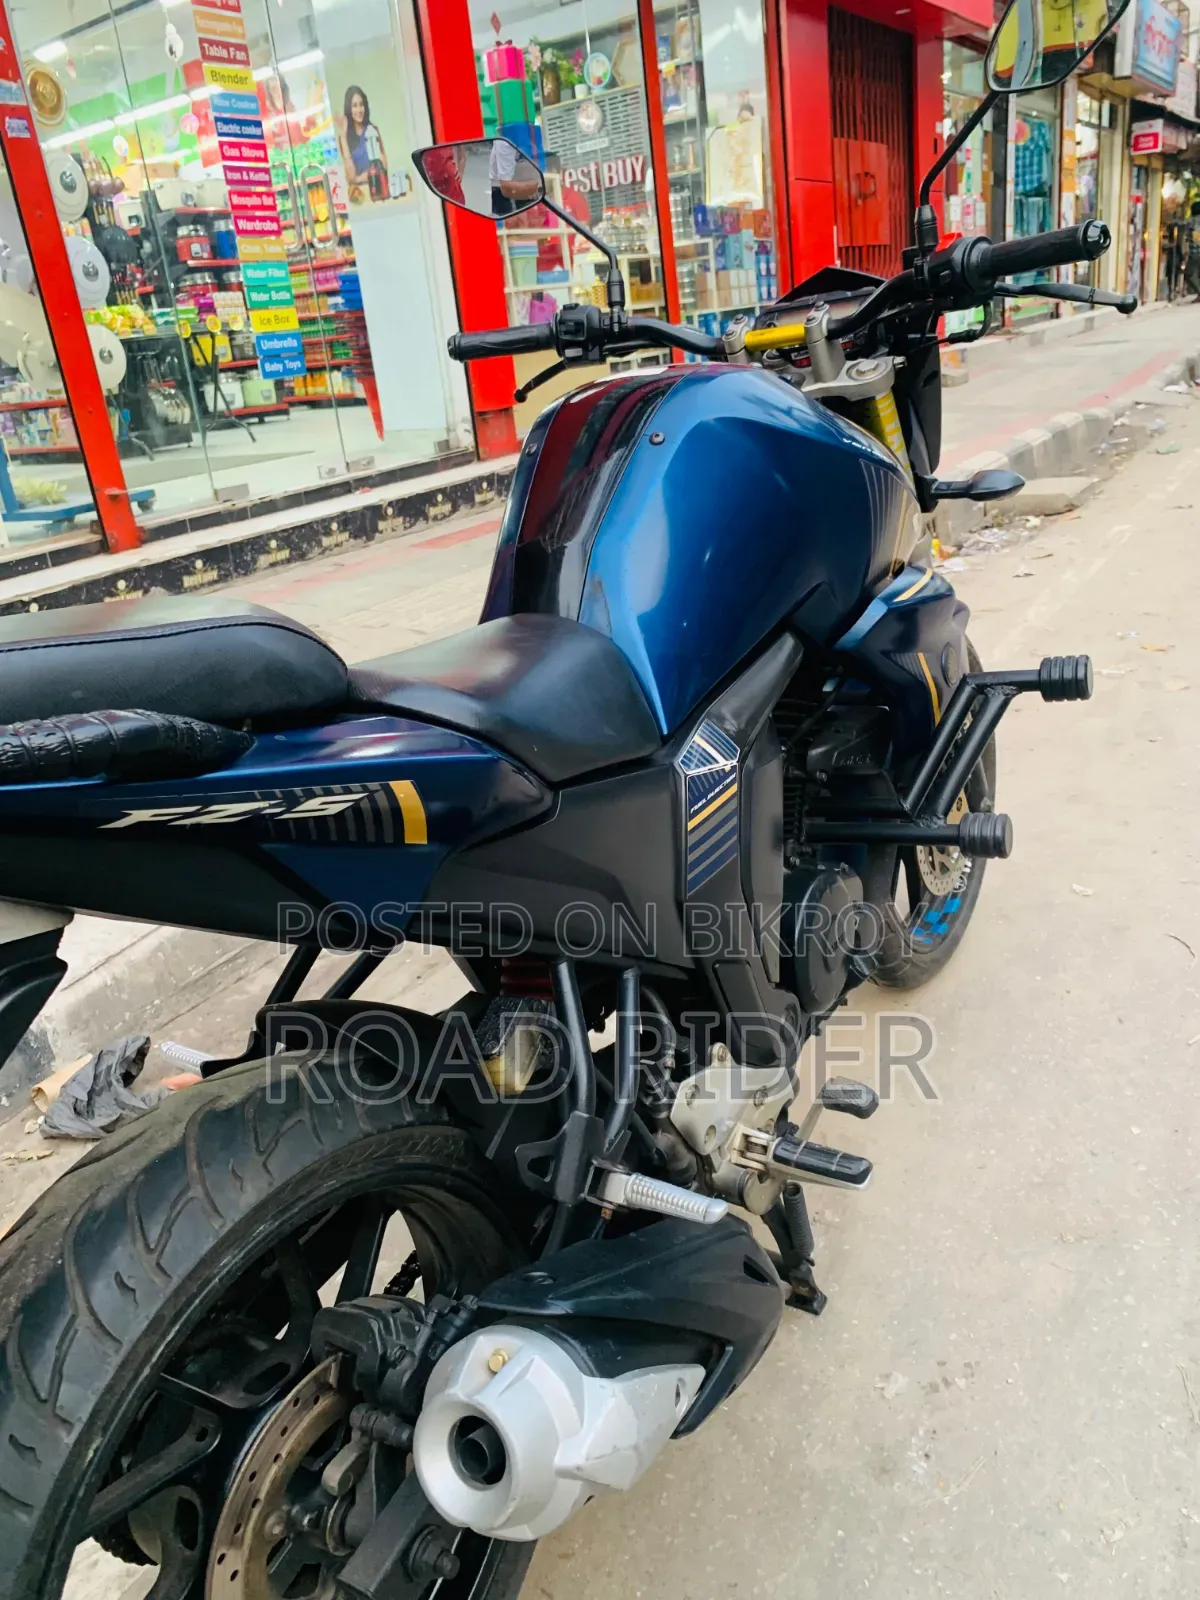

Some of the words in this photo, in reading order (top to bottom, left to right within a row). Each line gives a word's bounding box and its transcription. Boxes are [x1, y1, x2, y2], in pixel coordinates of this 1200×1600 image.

[202, 42, 228, 59] Table
[229, 47, 247, 61] Fan
[210, 70, 249, 86] Blender
[217, 121, 241, 134] Electric
[222, 145, 241, 157] Gas
[241, 146, 265, 159] Stove
[226, 169, 242, 180] Iron
[249, 171, 270, 182] Kettle
[562, 161, 600, 193] est
[602, 155, 645, 188] BUY
[231, 194, 262, 208] Mosquito
[236, 218, 279, 231] Wardrobe
[245, 268, 267, 278] Water
[250, 291, 270, 301] Water
[270, 290, 291, 301] Bottle
[259, 315, 272, 326] Ice
[273, 314, 292, 325] Box
[260, 337, 298, 350] Umbrella
[264, 361, 284, 373] Baby
[284, 359, 302, 371] Toys
[690, 797, 707, 814] FUEL
[706, 771, 737, 801] INJECTION
